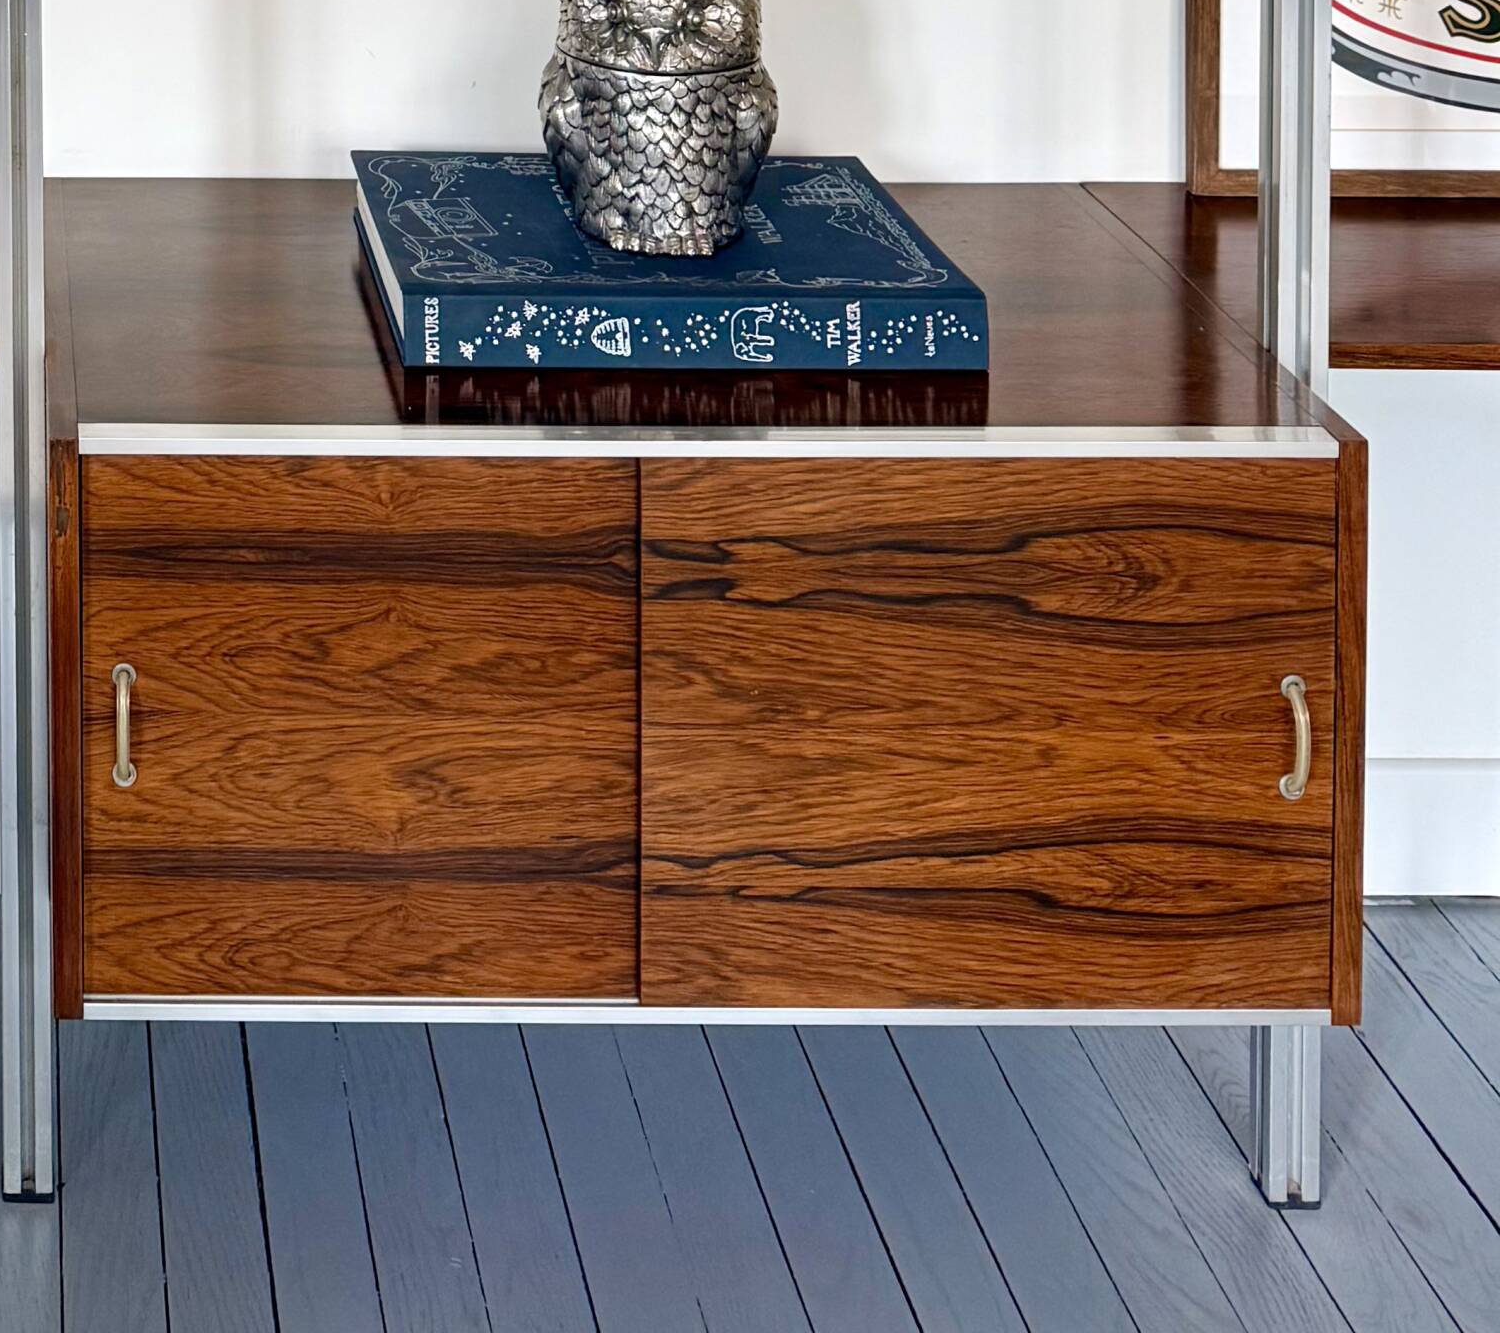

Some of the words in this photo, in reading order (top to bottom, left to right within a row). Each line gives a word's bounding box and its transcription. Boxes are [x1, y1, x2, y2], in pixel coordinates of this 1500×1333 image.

[425, 297, 439, 364] PICTURES
[827, 319, 842, 348] TIM
[847, 301, 861, 366] WALKER
[924, 315, 936, 357] teNeues
